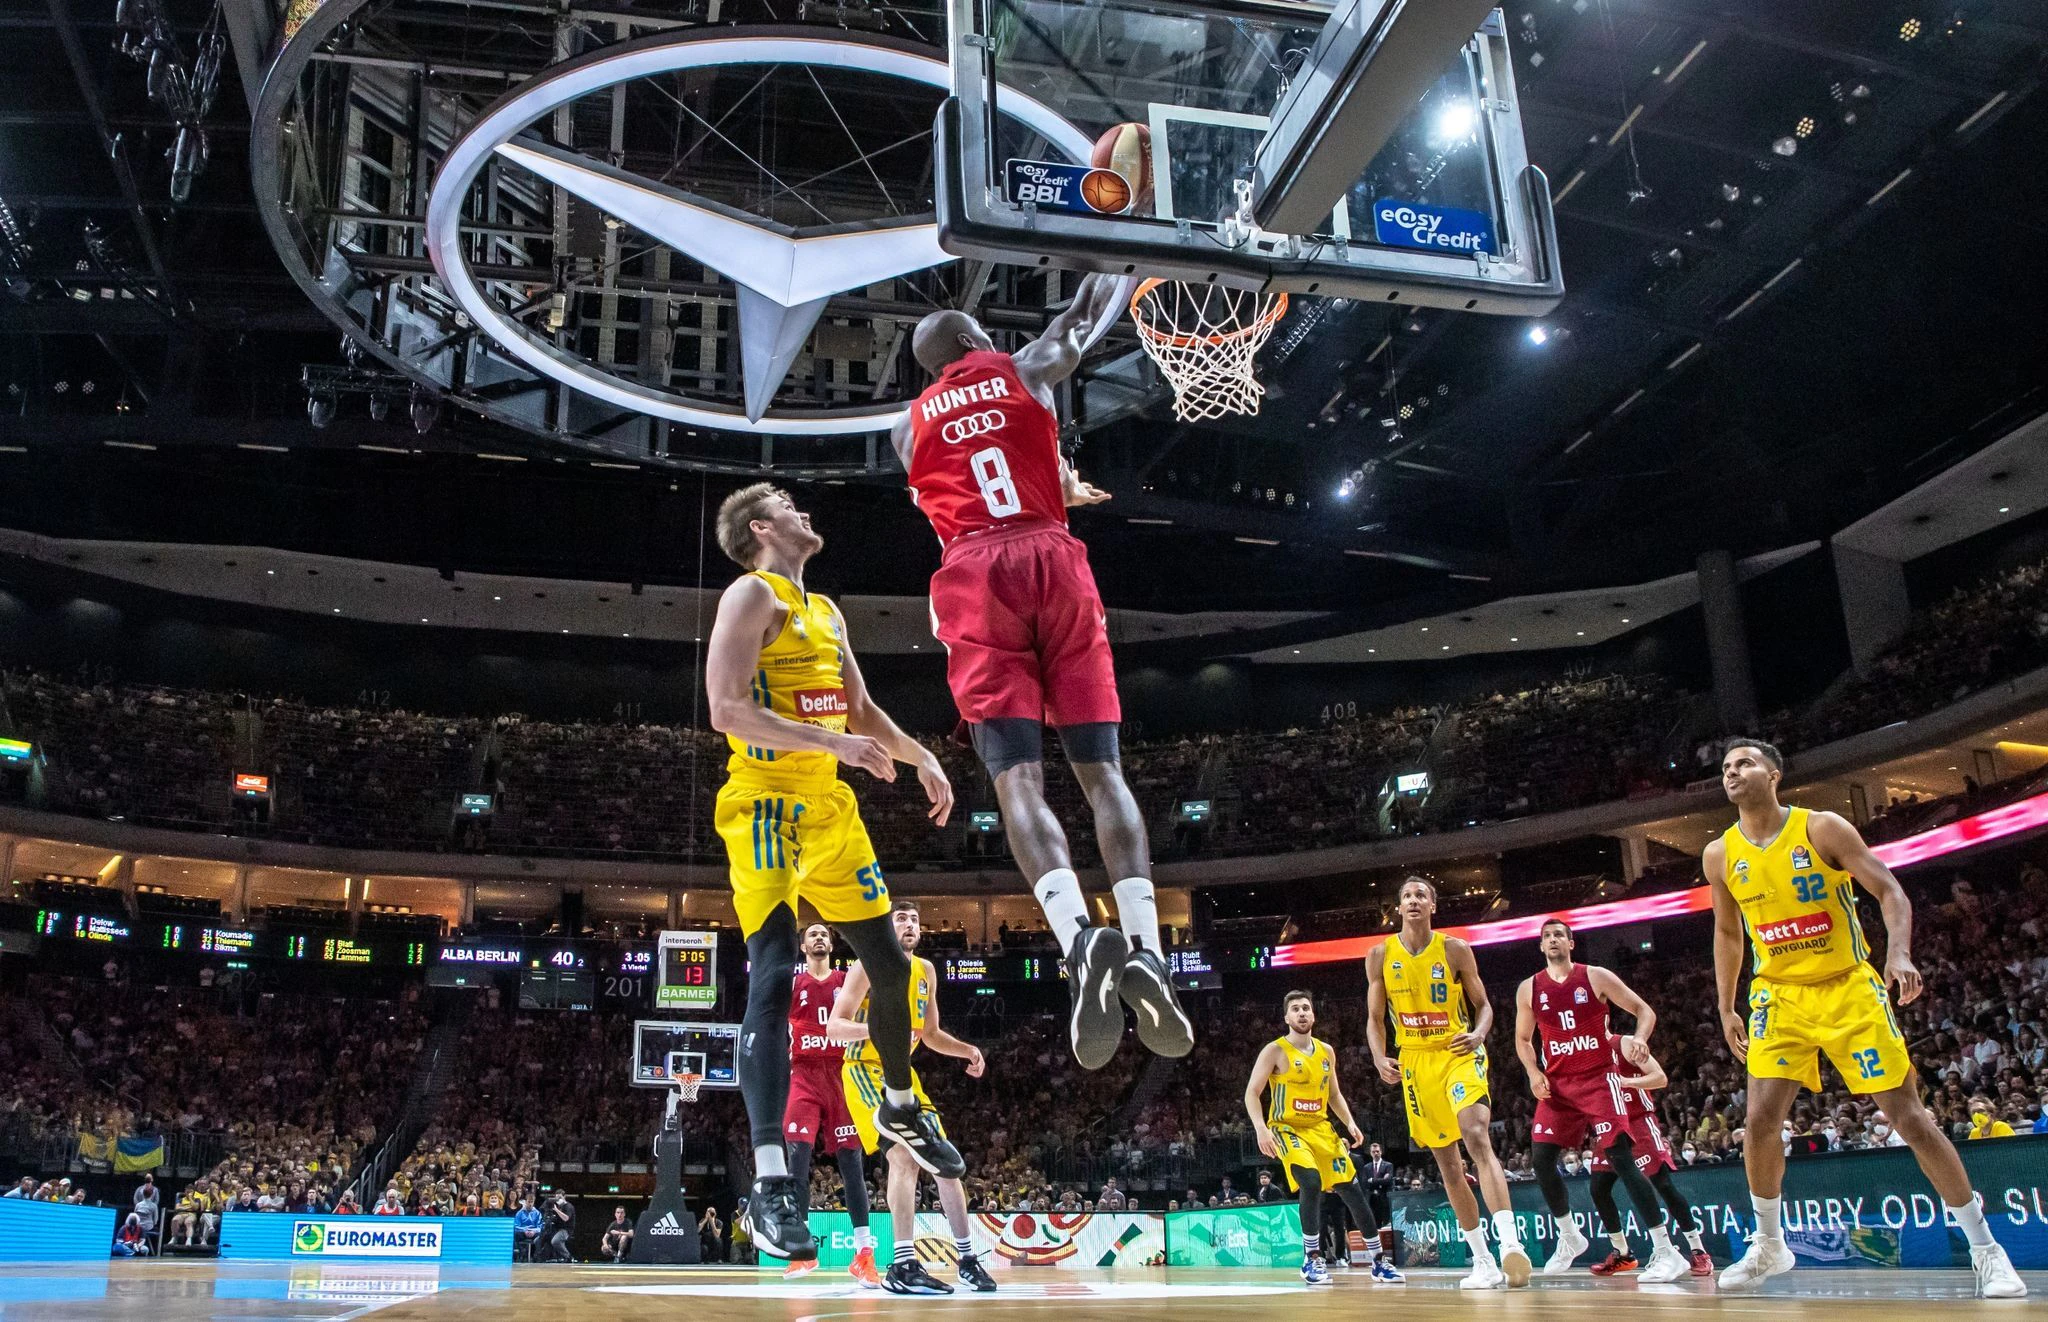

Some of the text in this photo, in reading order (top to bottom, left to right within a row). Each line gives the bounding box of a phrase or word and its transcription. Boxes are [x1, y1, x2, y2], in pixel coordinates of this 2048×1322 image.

[1017, 183, 1069, 206] BBL
[921, 376, 1010, 422] HUNTER
[970, 446, 1022, 518] 8
[1320, 701, 1358, 721] 408
[1792, 872, 1829, 903] 32
[665, 936, 703, 945] interseroh
[1768, 936, 1827, 957] ODYGUARD
[440, 948, 521, 962] ALBA BERLIN
[551, 951, 574, 966] 40
[577, 958, 584, 967] 2
[685, 966, 704, 984] 13
[604, 976, 643, 997] 201
[661, 987, 716, 1000] BARMER
[1430, 982, 1448, 1003] 19
[817, 1006, 828, 1025] 0
[1402, 1013, 1449, 1028] bett1.com
[1558, 1009, 1577, 1031] 16
[1550, 1034, 1599, 1057] BayWa
[1852, 1047, 1885, 1080] 32
[1414, 1219, 1450, 1244] VON
[1781, 1196, 1864, 1232] URRY
[326, 1230, 438, 1248] EUROMASTER
[650, 1225, 684, 1236] adidas
